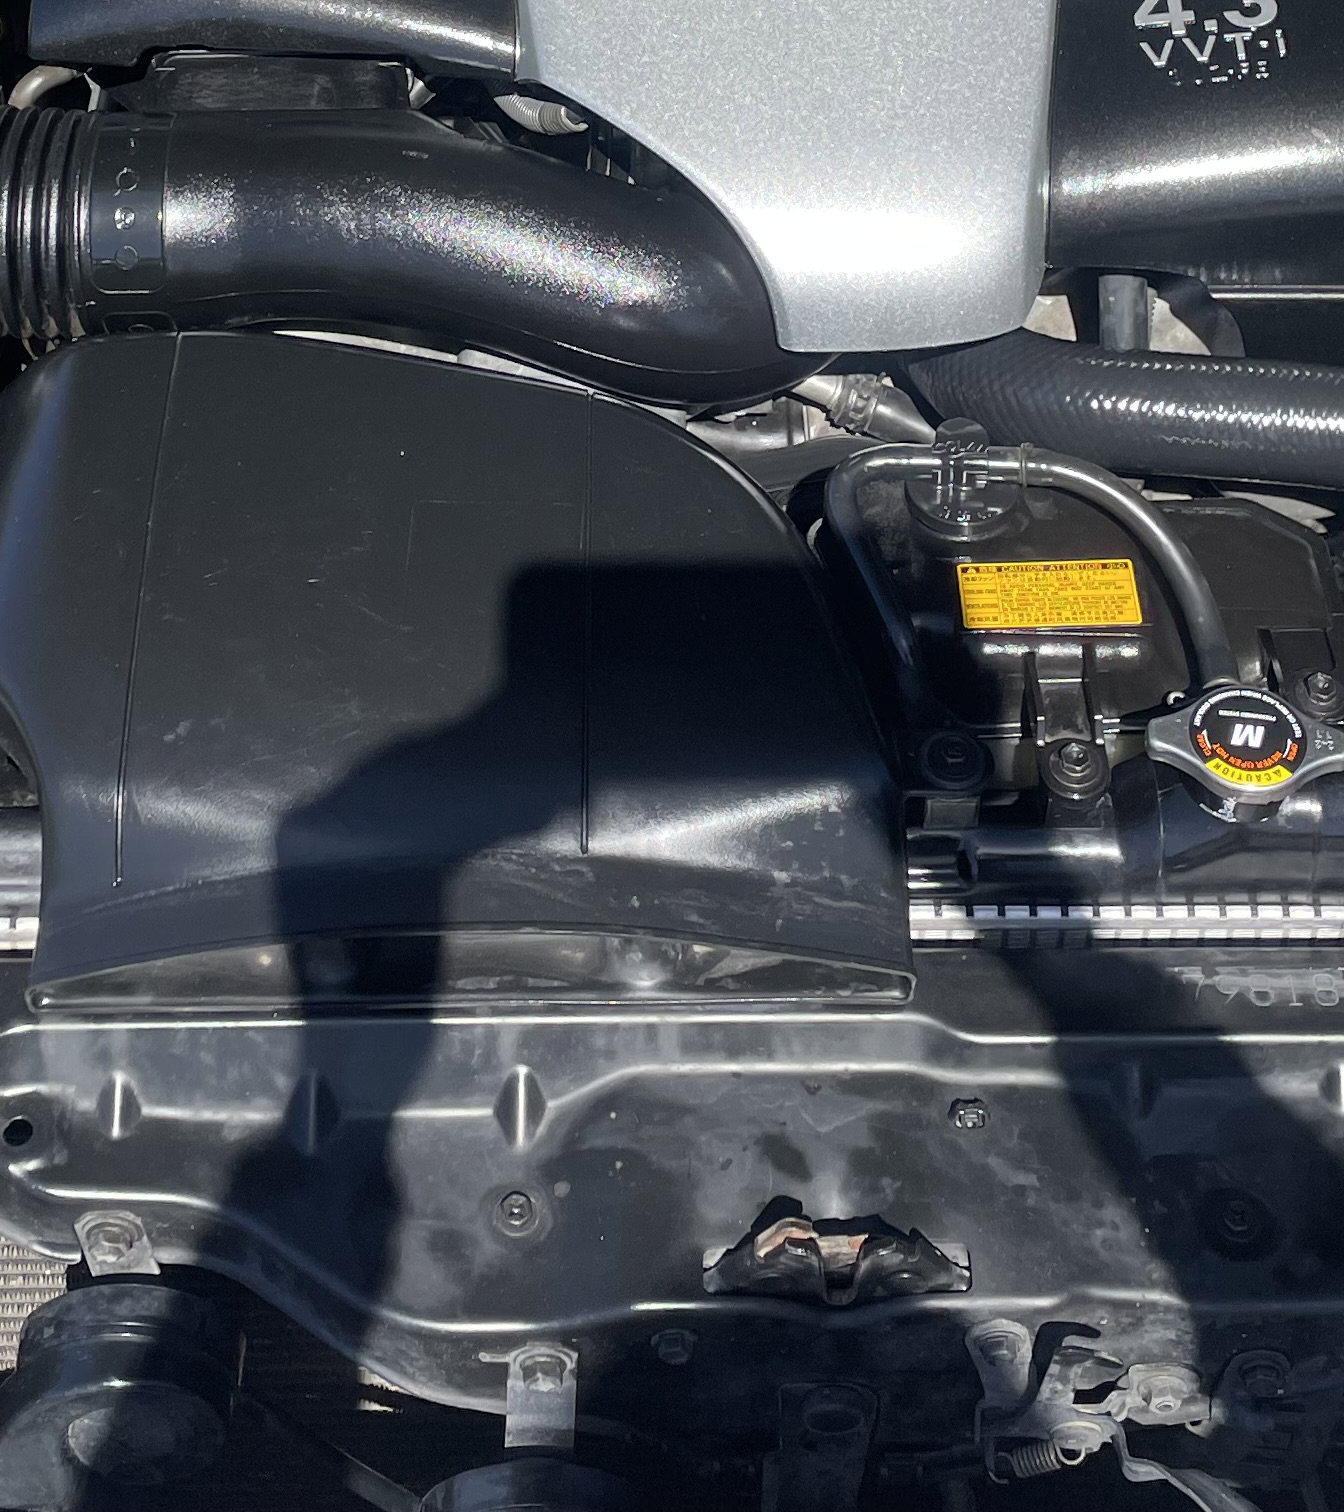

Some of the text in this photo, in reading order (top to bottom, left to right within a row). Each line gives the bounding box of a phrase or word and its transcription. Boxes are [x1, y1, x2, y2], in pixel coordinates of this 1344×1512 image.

[1211, 742, 1283, 770] NEVER OPEN HOT
[1212, 761, 1273, 782] CAUTION
